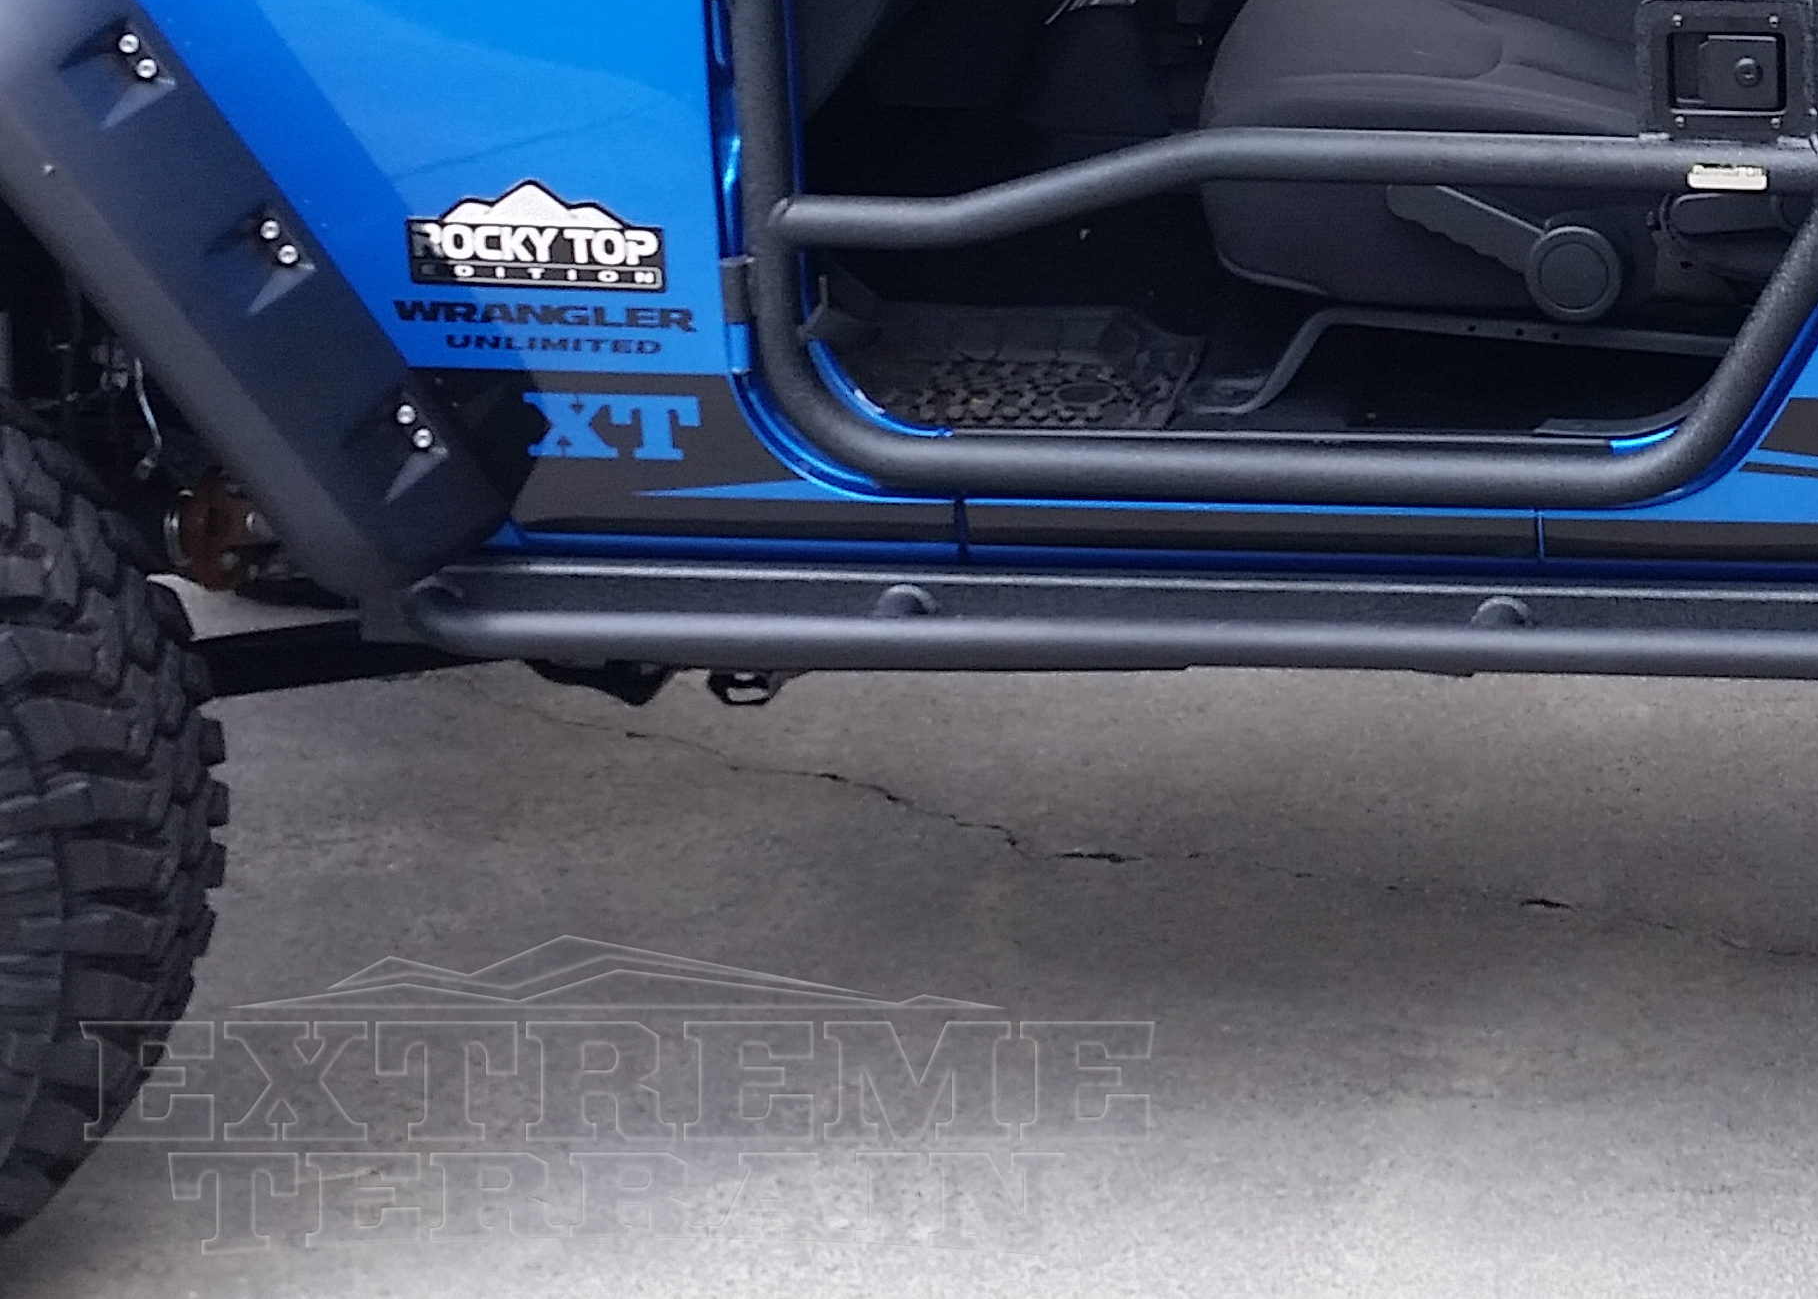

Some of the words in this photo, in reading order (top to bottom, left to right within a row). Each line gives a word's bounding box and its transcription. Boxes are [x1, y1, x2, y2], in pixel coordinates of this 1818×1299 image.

[411, 222, 559, 263] ROCKY
[563, 229, 659, 266] TOP
[394, 299, 697, 333] WRANGLER
[444, 333, 663, 354] UNLIMITED
[522, 392, 703, 461] XT
